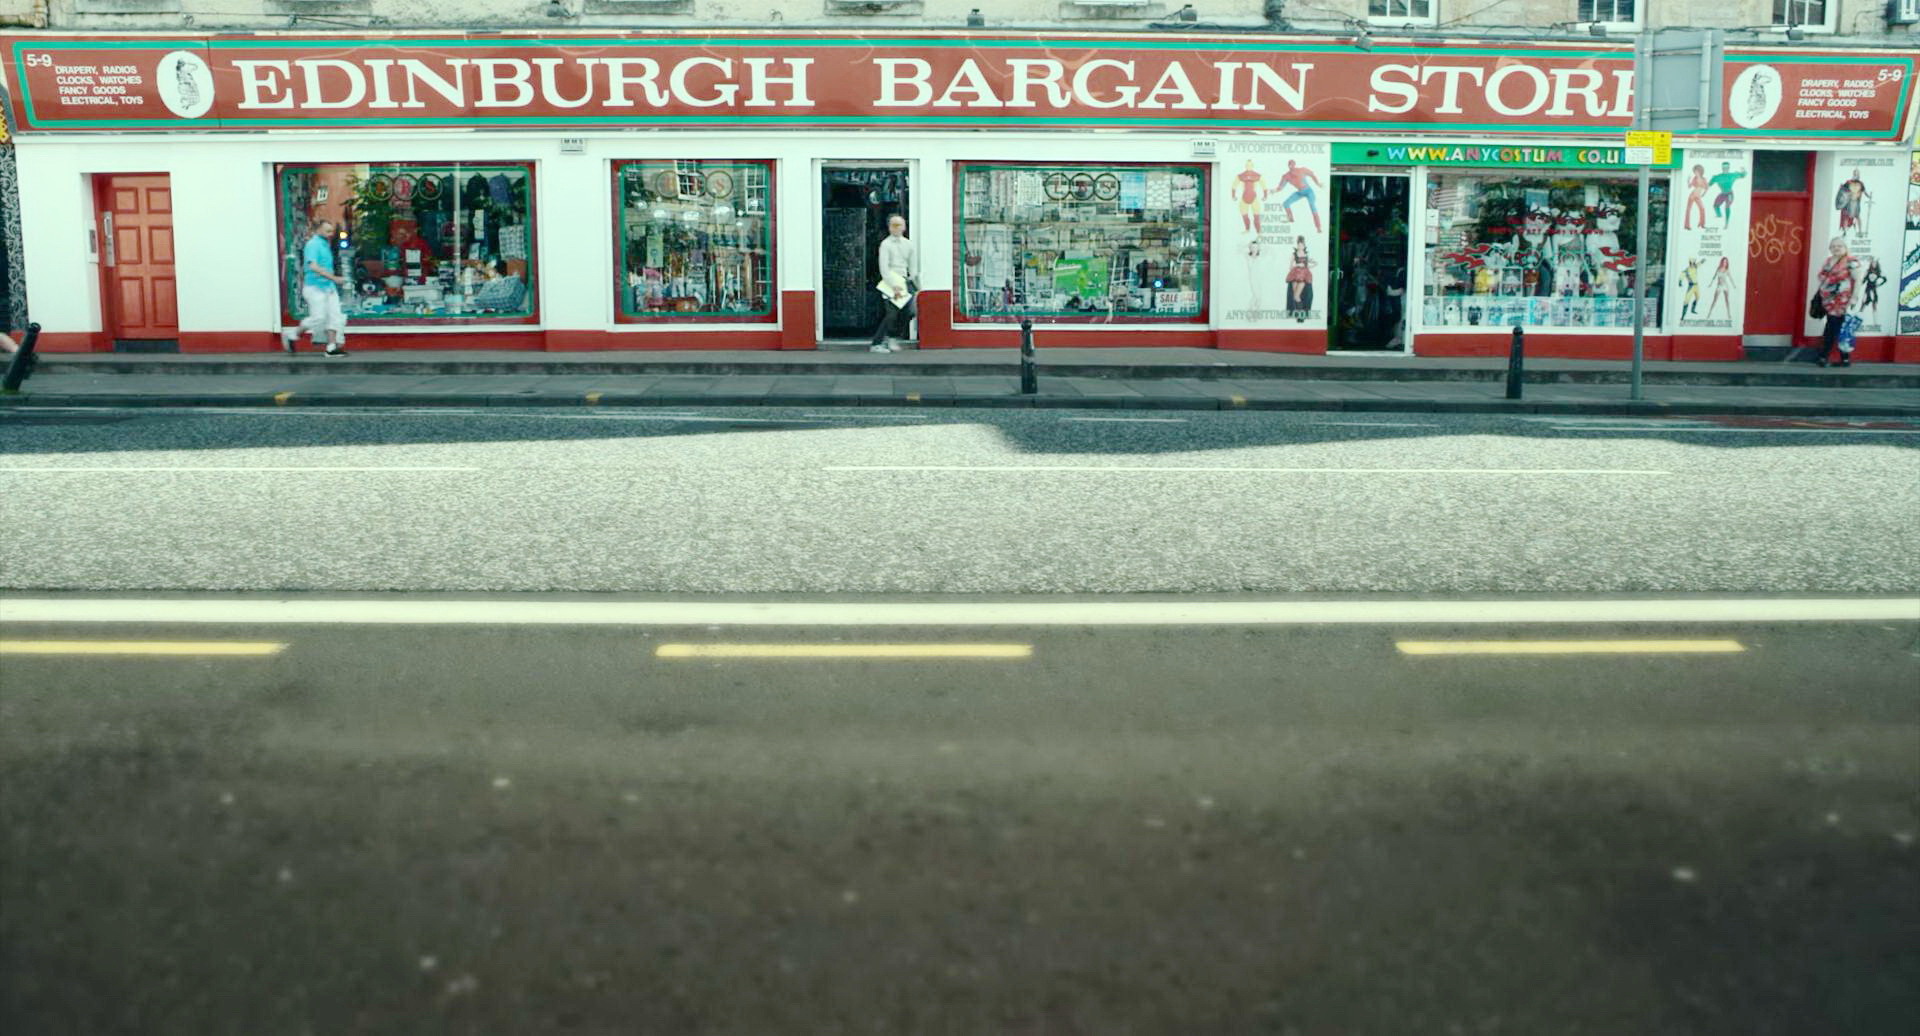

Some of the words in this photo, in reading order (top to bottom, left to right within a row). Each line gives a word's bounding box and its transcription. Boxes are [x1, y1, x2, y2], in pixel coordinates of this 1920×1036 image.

[27, 54, 52, 67] 5-9
[55, 66, 99, 75] DRAPERY,
[103, 66, 137, 74] RADIOS
[1877, 69, 1902, 82] 5-9
[56, 76, 95, 85] CLOCKS,
[100, 76, 142, 84] WATCHES
[231, 57, 816, 109] EDINBURGH
[872, 57, 1315, 111] BARGAIN
[1801, 79, 1839, 88] DRAPERY,
[1844, 79, 1875, 88] RADIOS
[59, 86, 88, 95] FANCY
[93, 86, 126, 95] GOODS
[1799, 89, 1834, 98] CLOCKS,
[1838, 89, 1876, 98] WATCHES
[61, 96, 118, 106] ELECTRICAL,
[121, 96, 144, 105] TOYS
[1797, 99, 1824, 107] FANCY
[1827, 99, 1857, 107] GOODS
[1795, 110, 1846, 120] ELECTRICAL,
[1849, 110, 1870, 119] TOYS
